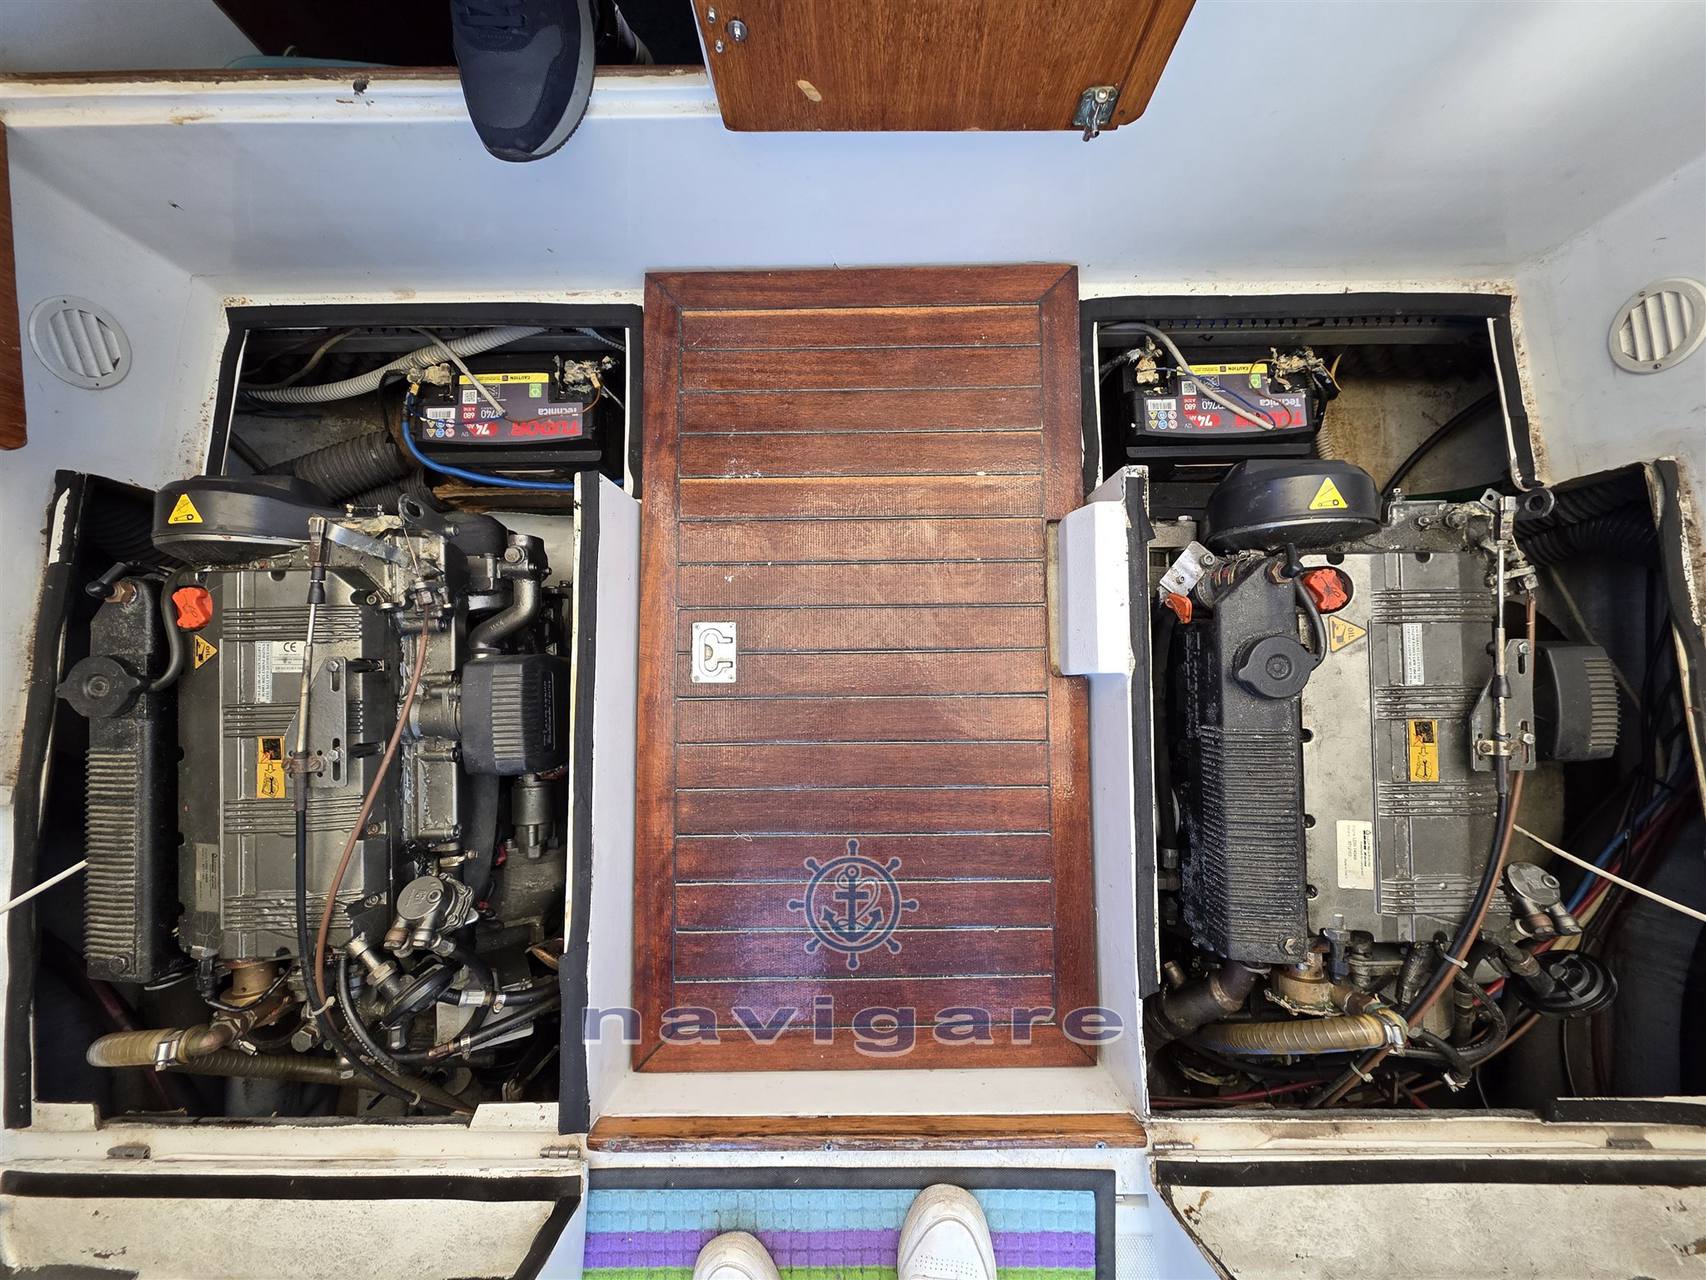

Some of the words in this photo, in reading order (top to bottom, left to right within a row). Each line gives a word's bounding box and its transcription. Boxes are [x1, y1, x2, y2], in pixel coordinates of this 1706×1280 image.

[463, 411, 475, 419] 680
[538, 407, 578, 416] Technica
[1197, 415, 1213, 426] 74
[475, 423, 490, 435] 74
[283, 641, 297, 652] CE
